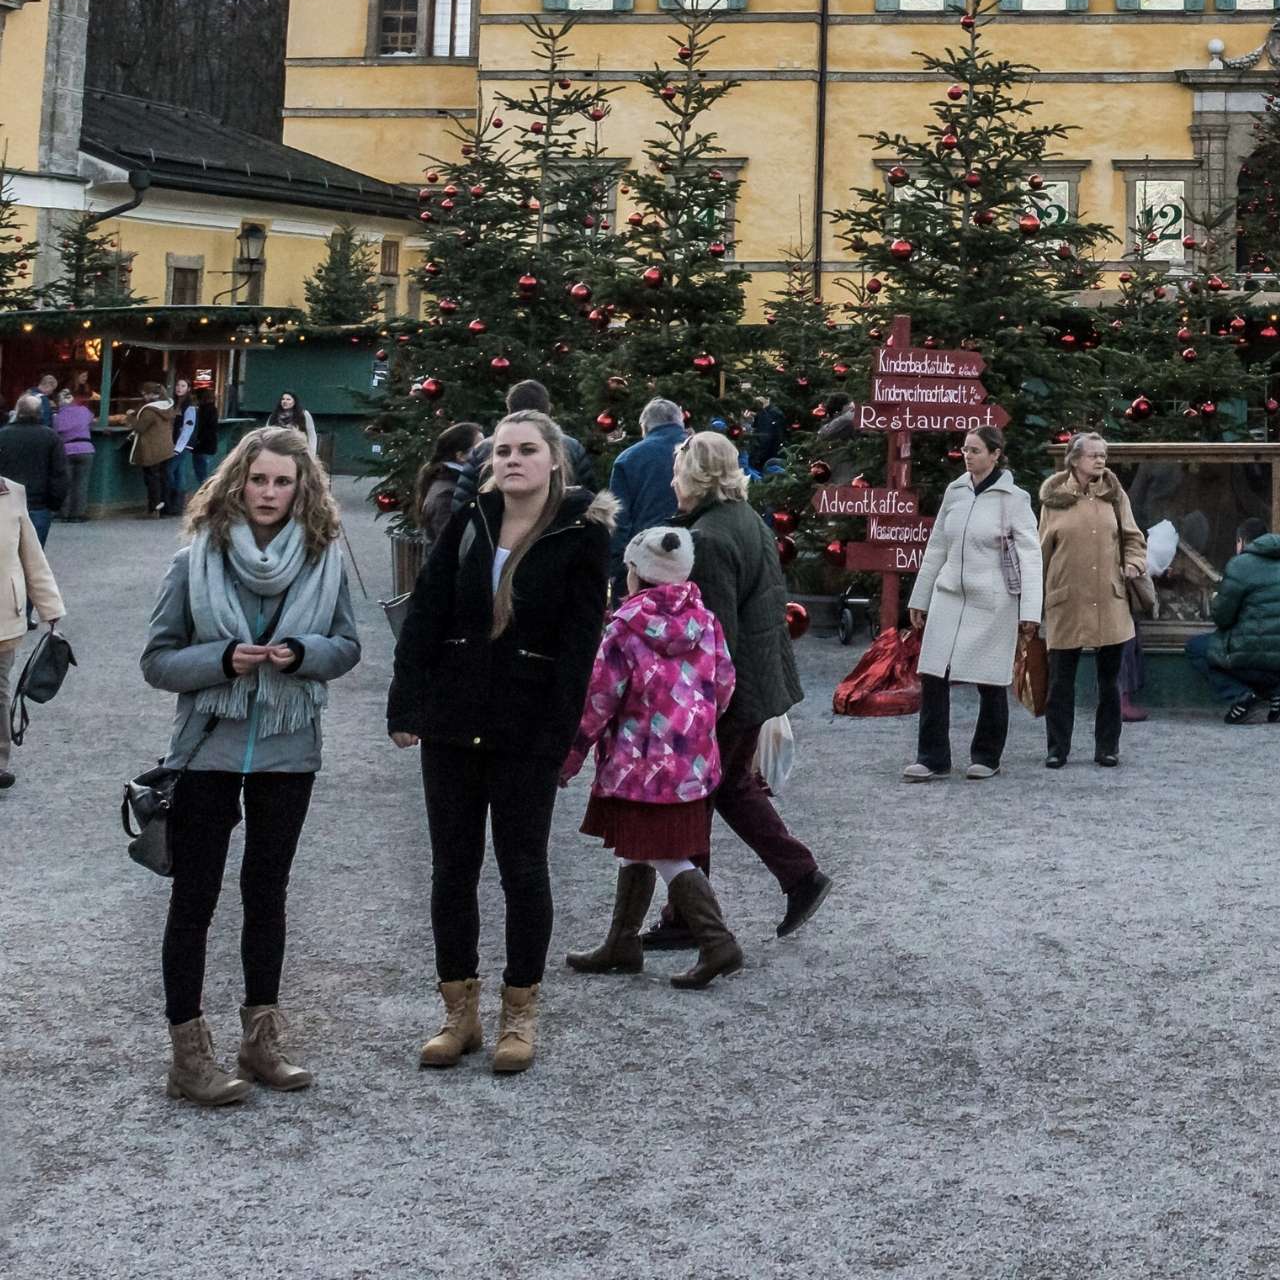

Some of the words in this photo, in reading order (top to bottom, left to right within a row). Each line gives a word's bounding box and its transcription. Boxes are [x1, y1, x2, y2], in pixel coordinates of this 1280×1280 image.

[879, 349, 956, 374] Kinderbackstube
[875, 379, 967, 404] Kinderweihnachtswelt
[860, 405, 994, 429] Restaurant
[819, 489, 914, 514] Adventkaffee
[870, 516, 928, 543] Wasserspiele
